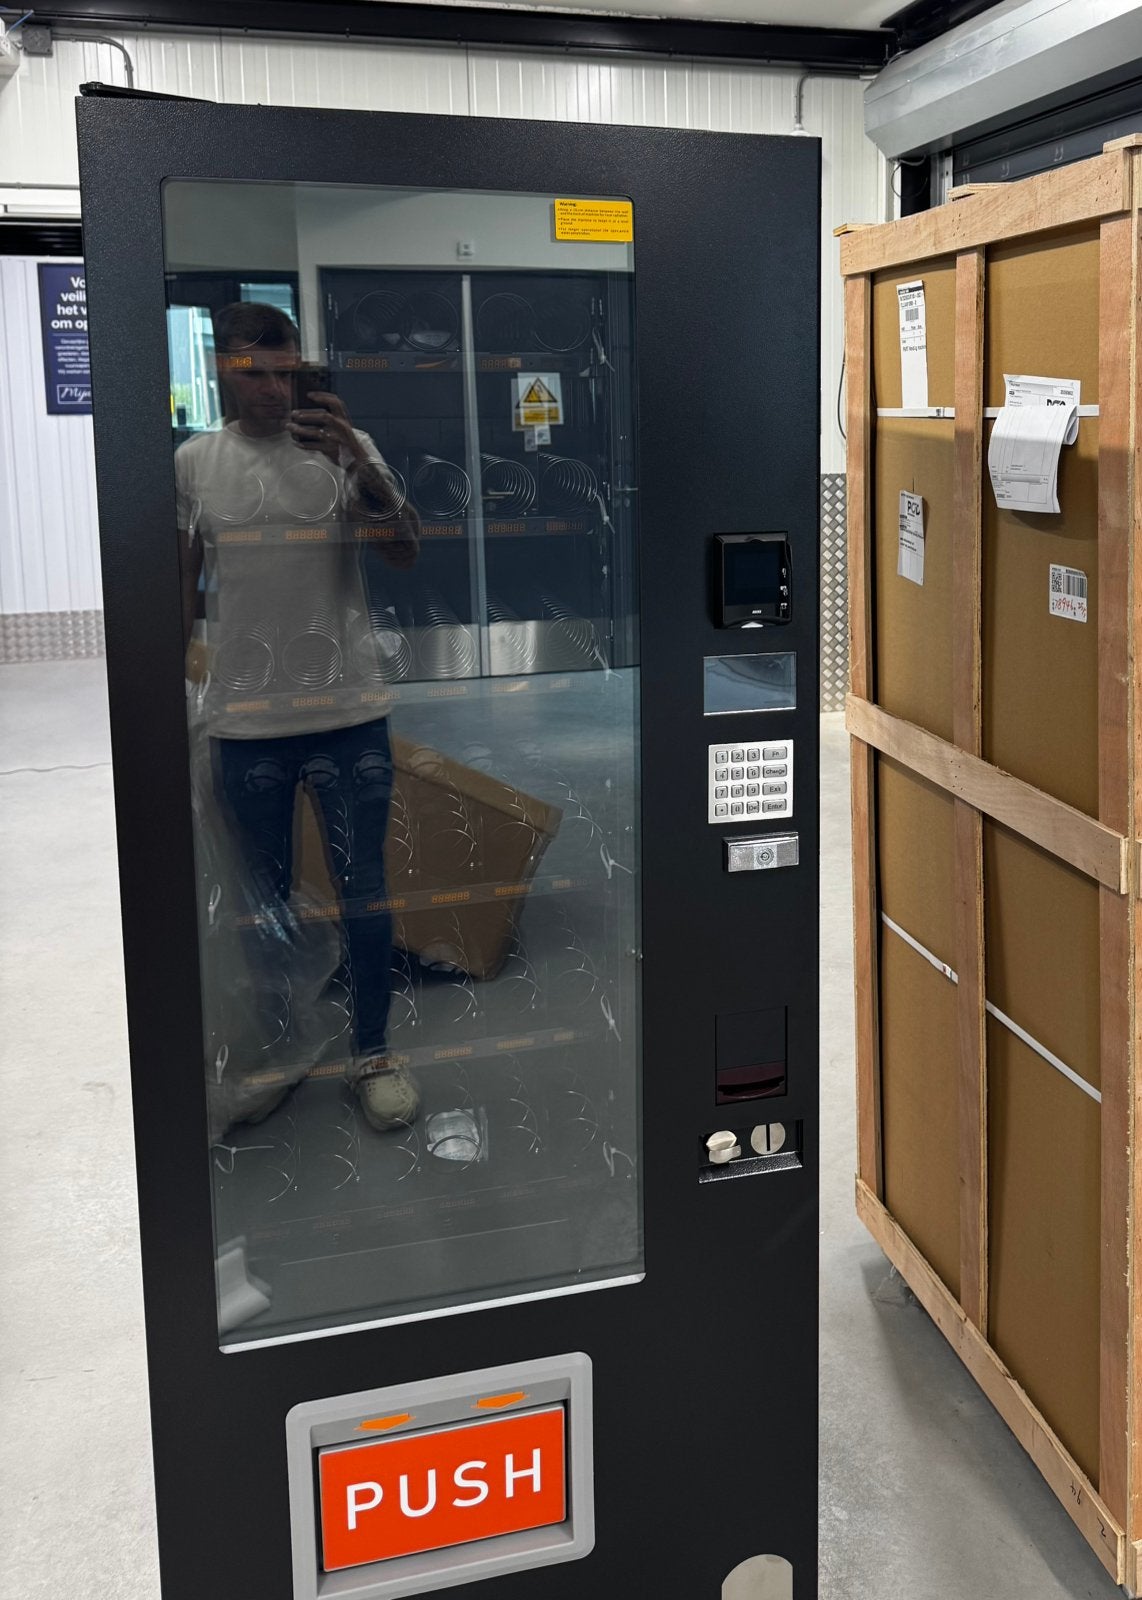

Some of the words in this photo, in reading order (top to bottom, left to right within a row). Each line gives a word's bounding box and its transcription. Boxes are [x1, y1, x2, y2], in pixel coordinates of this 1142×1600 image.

[56, 304, 78, 315] het
[51, 320, 72, 329] om
[346, 1448, 541, 1530] PUSH
